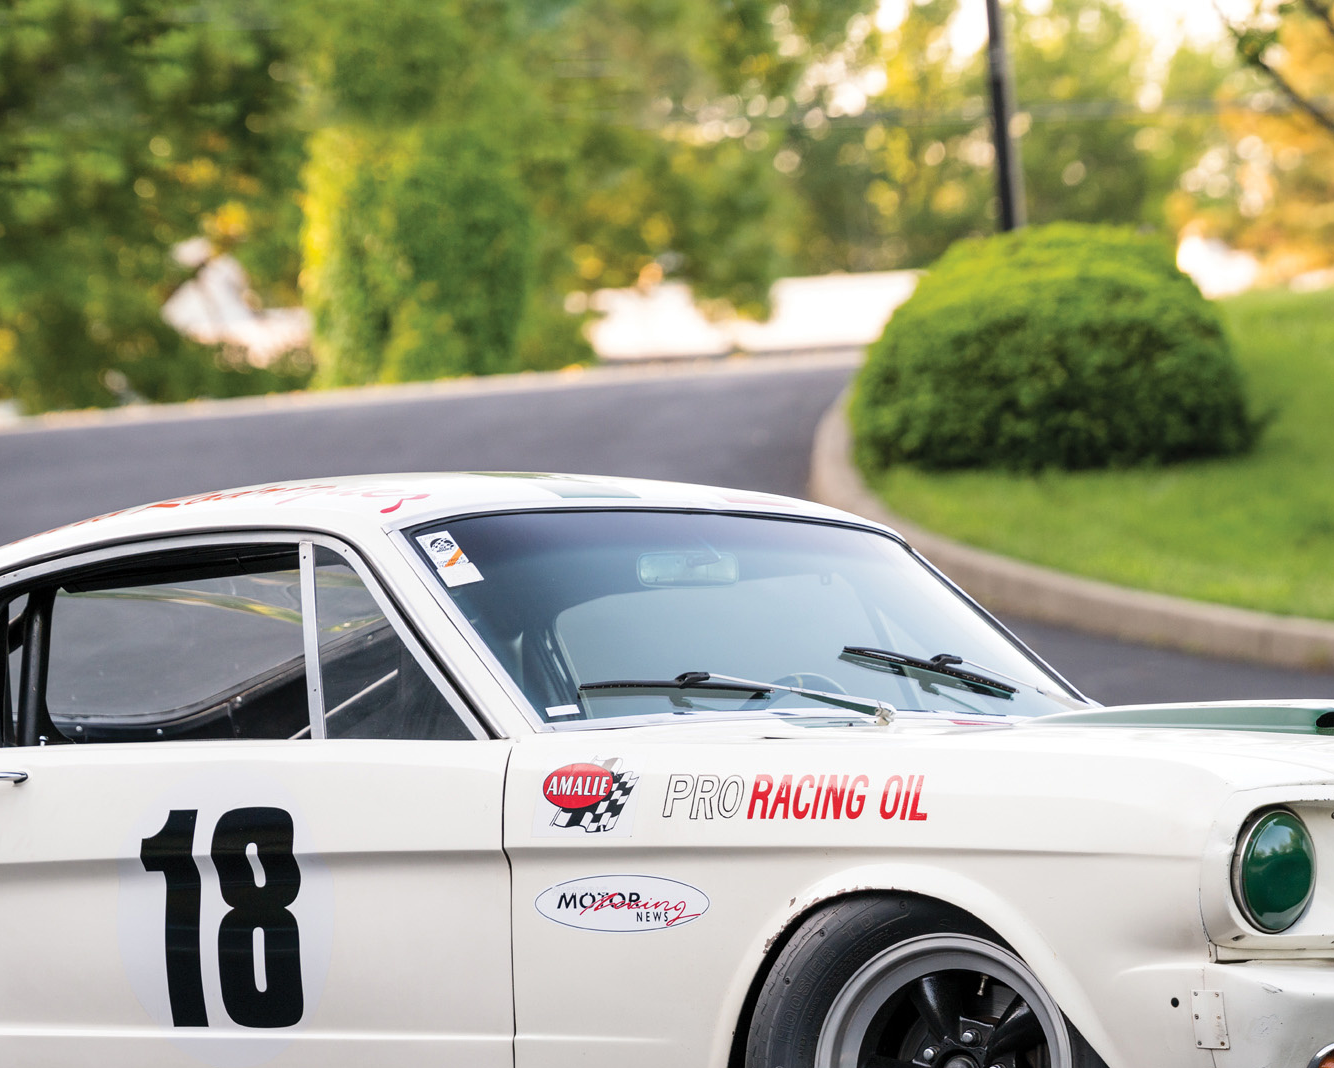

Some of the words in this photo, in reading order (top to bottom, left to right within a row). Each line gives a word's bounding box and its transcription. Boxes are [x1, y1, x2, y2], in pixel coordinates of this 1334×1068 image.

[546, 775, 611, 796] AMALIE
[662, 774, 746, 820] PRO
[747, 774, 869, 820] RACING
[879, 774, 927, 821] OIL
[140, 806, 304, 1028] 18
[557, 892, 641, 909] MOTOR
[636, 911, 669, 922] NEWS
[775, 946, 837, 1045] HOOSIER
